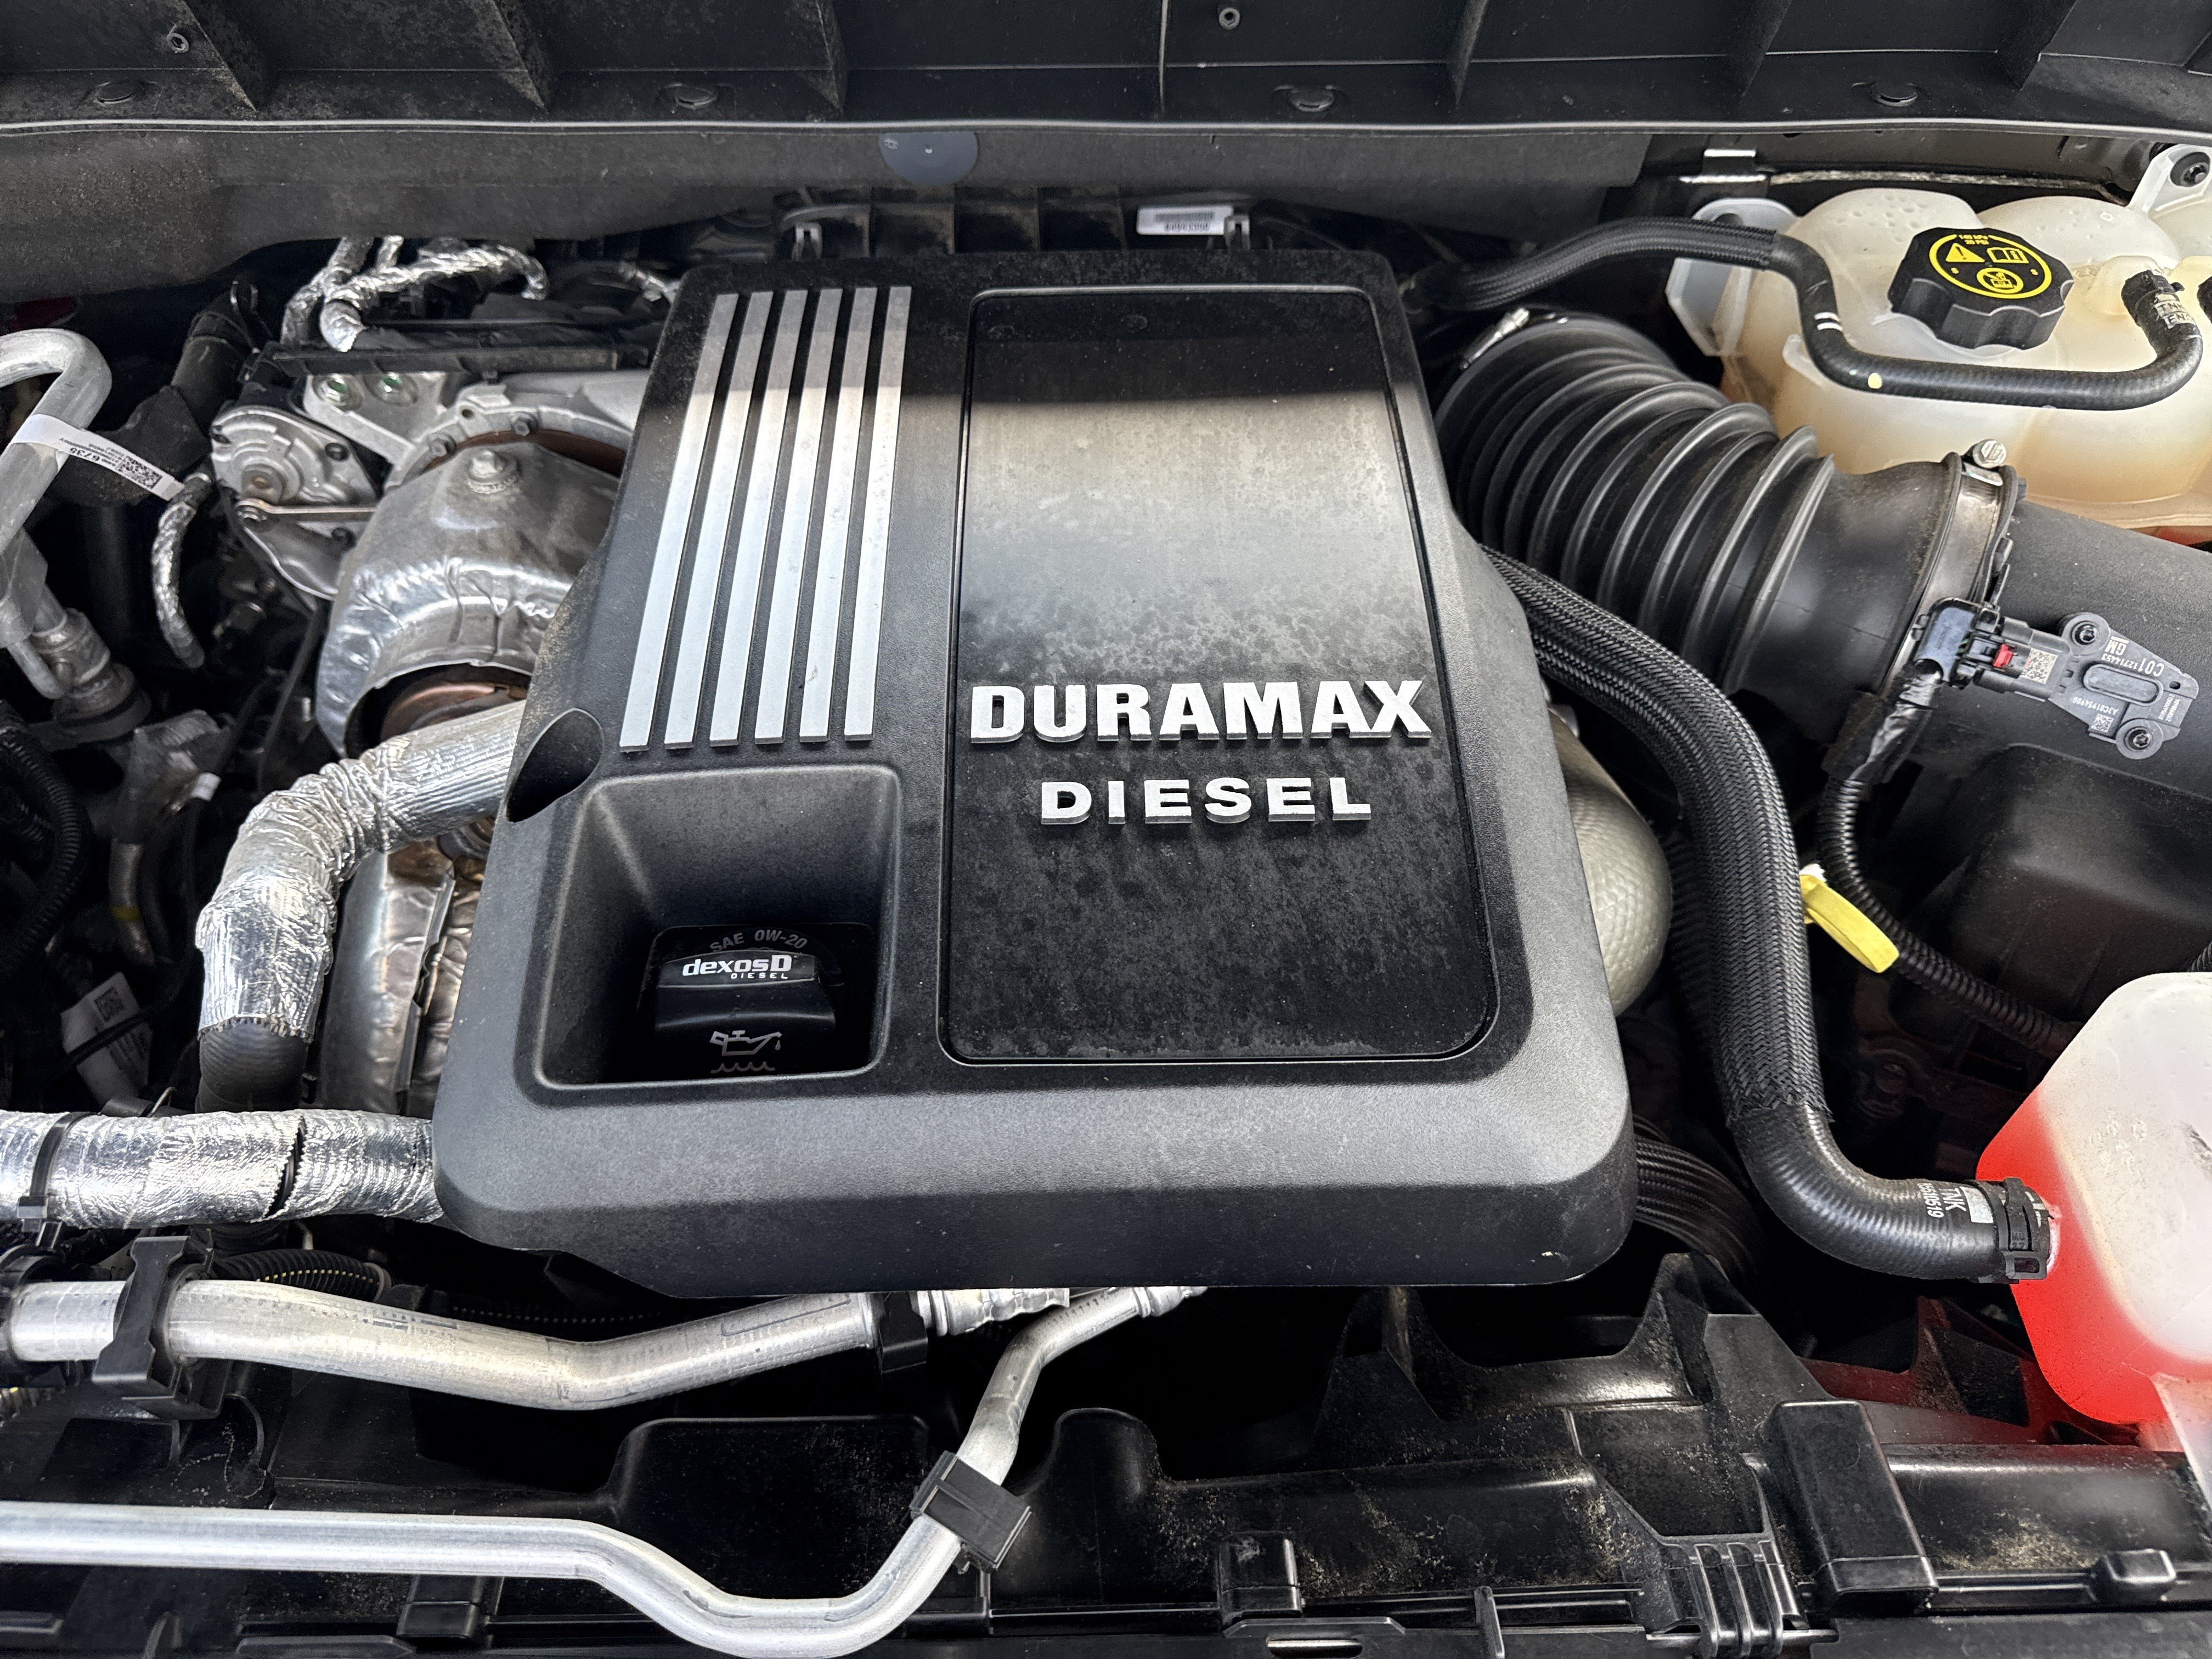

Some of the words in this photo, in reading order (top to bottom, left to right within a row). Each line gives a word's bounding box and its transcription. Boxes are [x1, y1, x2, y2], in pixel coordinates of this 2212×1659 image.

[70, 447, 100, 461] 6735
[2105, 639, 2128, 656] GM
[2102, 653, 2138, 670] 12714453
[2138, 658, 2164, 677] C01
[970, 680, 1432, 744] DURAMAX
[1041, 777, 1372, 825] DIESEL
[710, 933, 744, 952] SAE
[754, 929, 808, 949] 0W-20
[682, 954, 793, 976] dexosD
[1939, 1187, 1967, 1212] TNK
